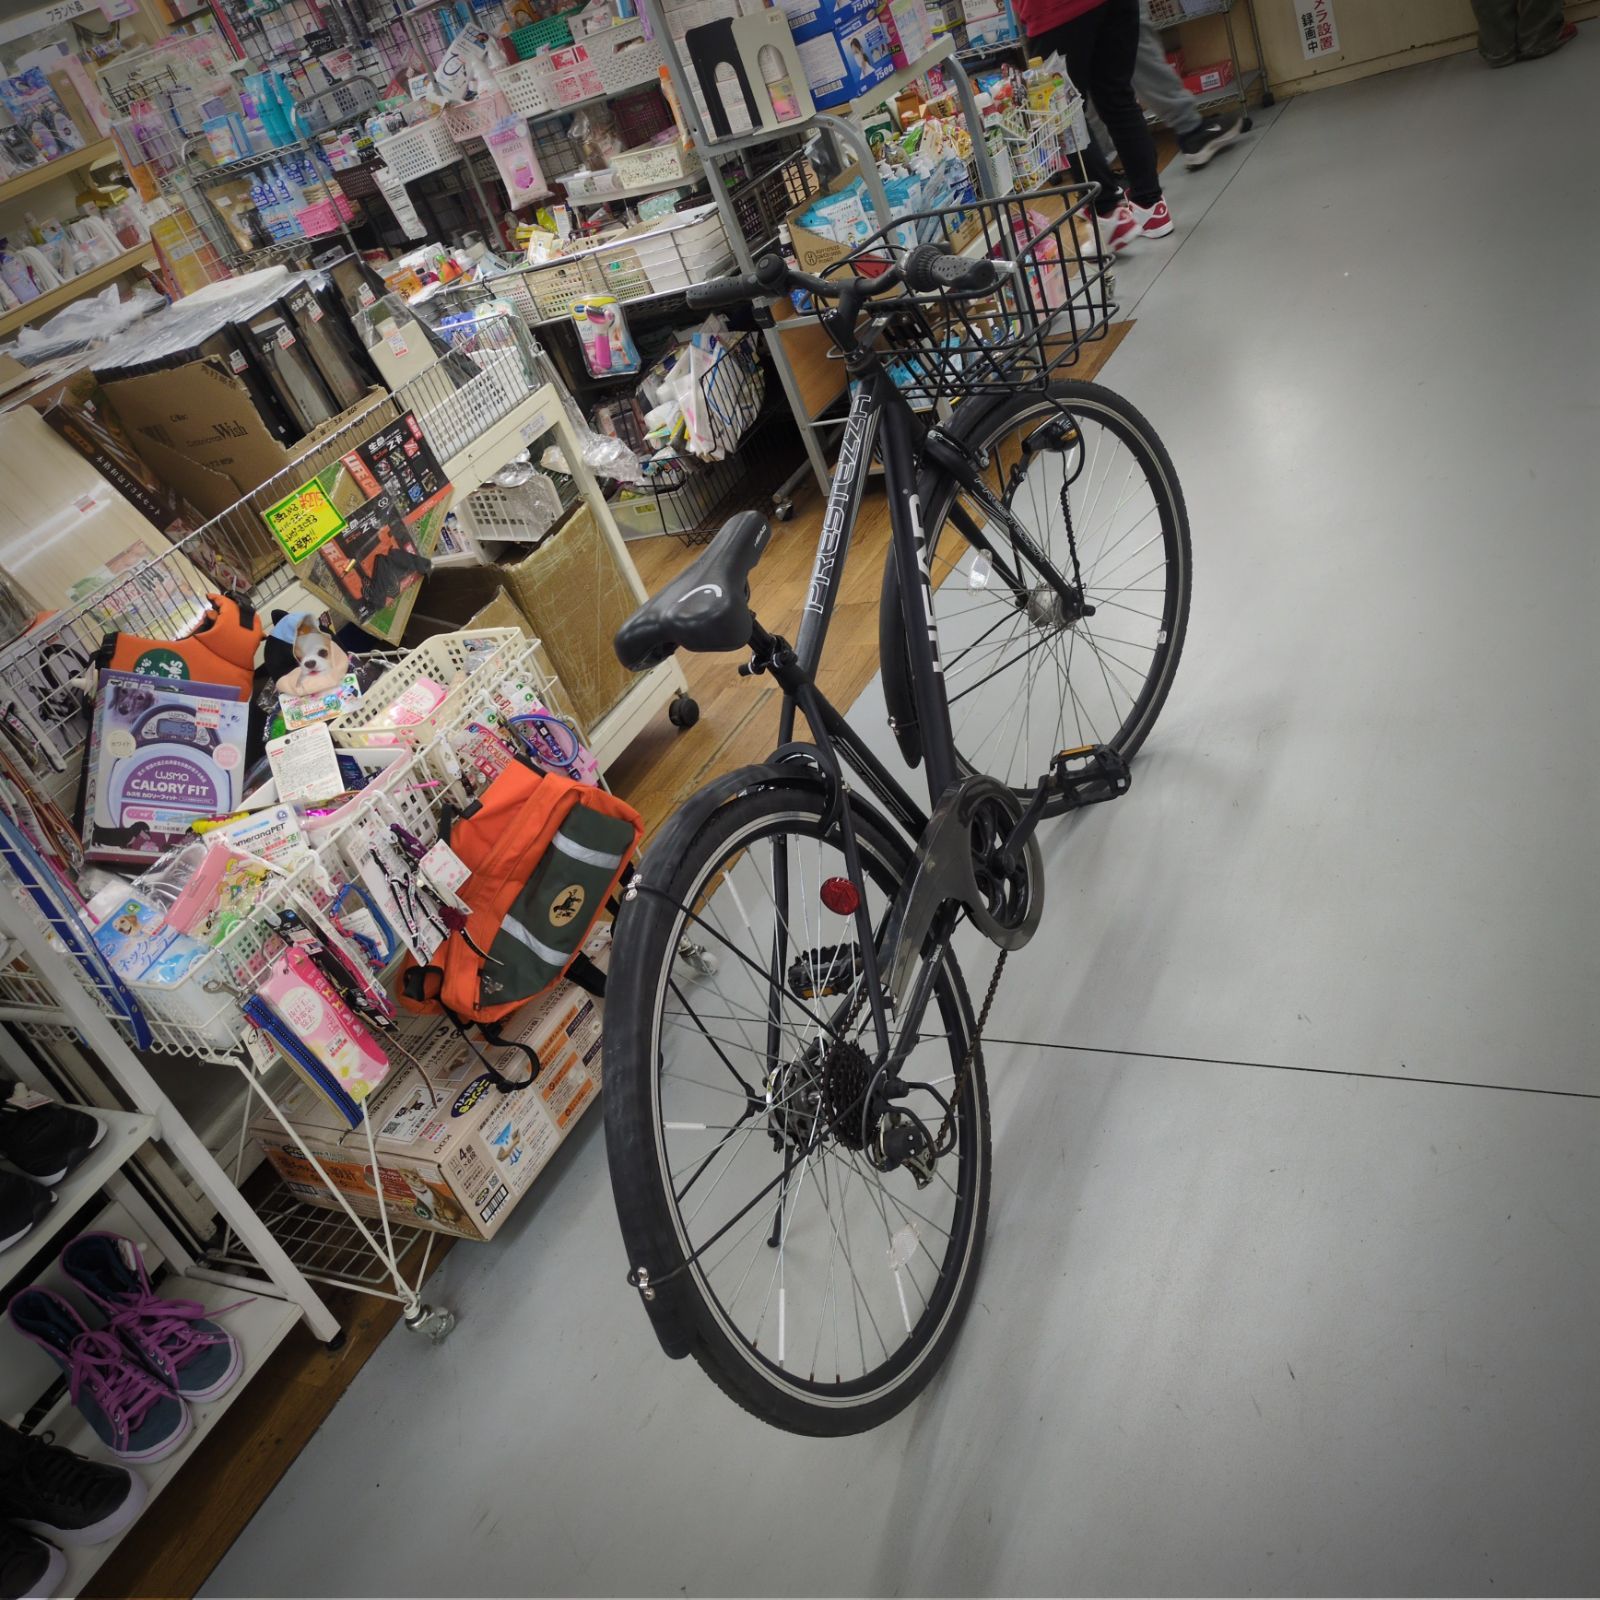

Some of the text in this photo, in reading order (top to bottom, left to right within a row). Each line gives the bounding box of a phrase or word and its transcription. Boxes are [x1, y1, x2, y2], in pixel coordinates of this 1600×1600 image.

[1300, 13, 1319, 53] 録画中
[875, 64, 896, 81] 7500
[213, 422, 249, 439] Wish
[805, 394, 871, 614] PRESTEZZA
[131, 778, 210, 797] CALORY FIT
